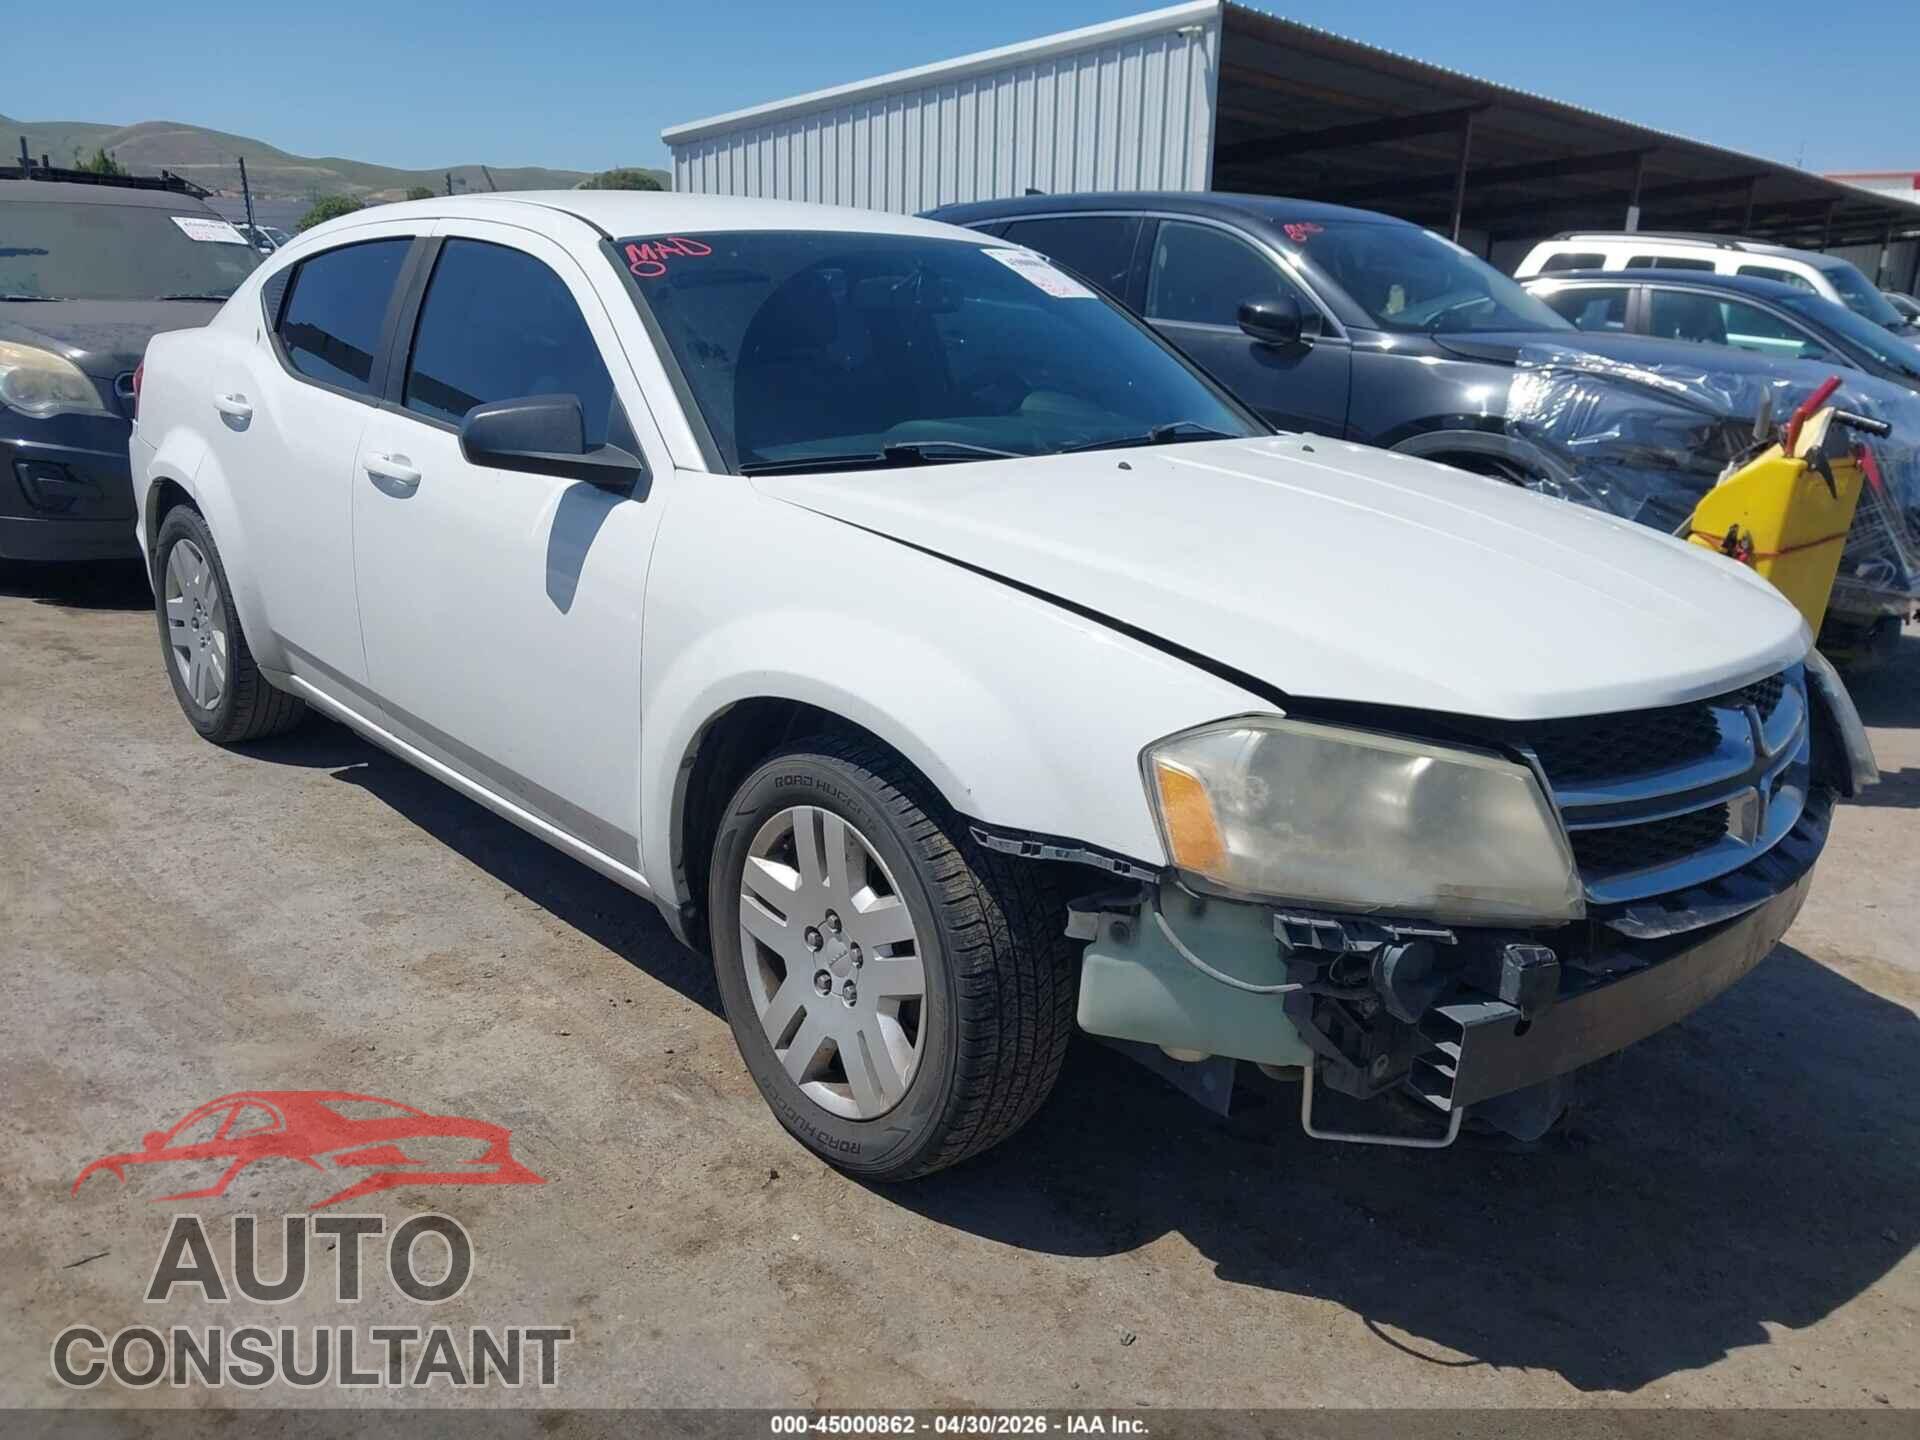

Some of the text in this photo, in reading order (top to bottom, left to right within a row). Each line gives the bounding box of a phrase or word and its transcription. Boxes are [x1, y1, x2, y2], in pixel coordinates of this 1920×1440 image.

[624, 236, 712, 263] MAD
[775, 775, 813, 788] ROAD
[816, 1131, 862, 1155] ROAD
